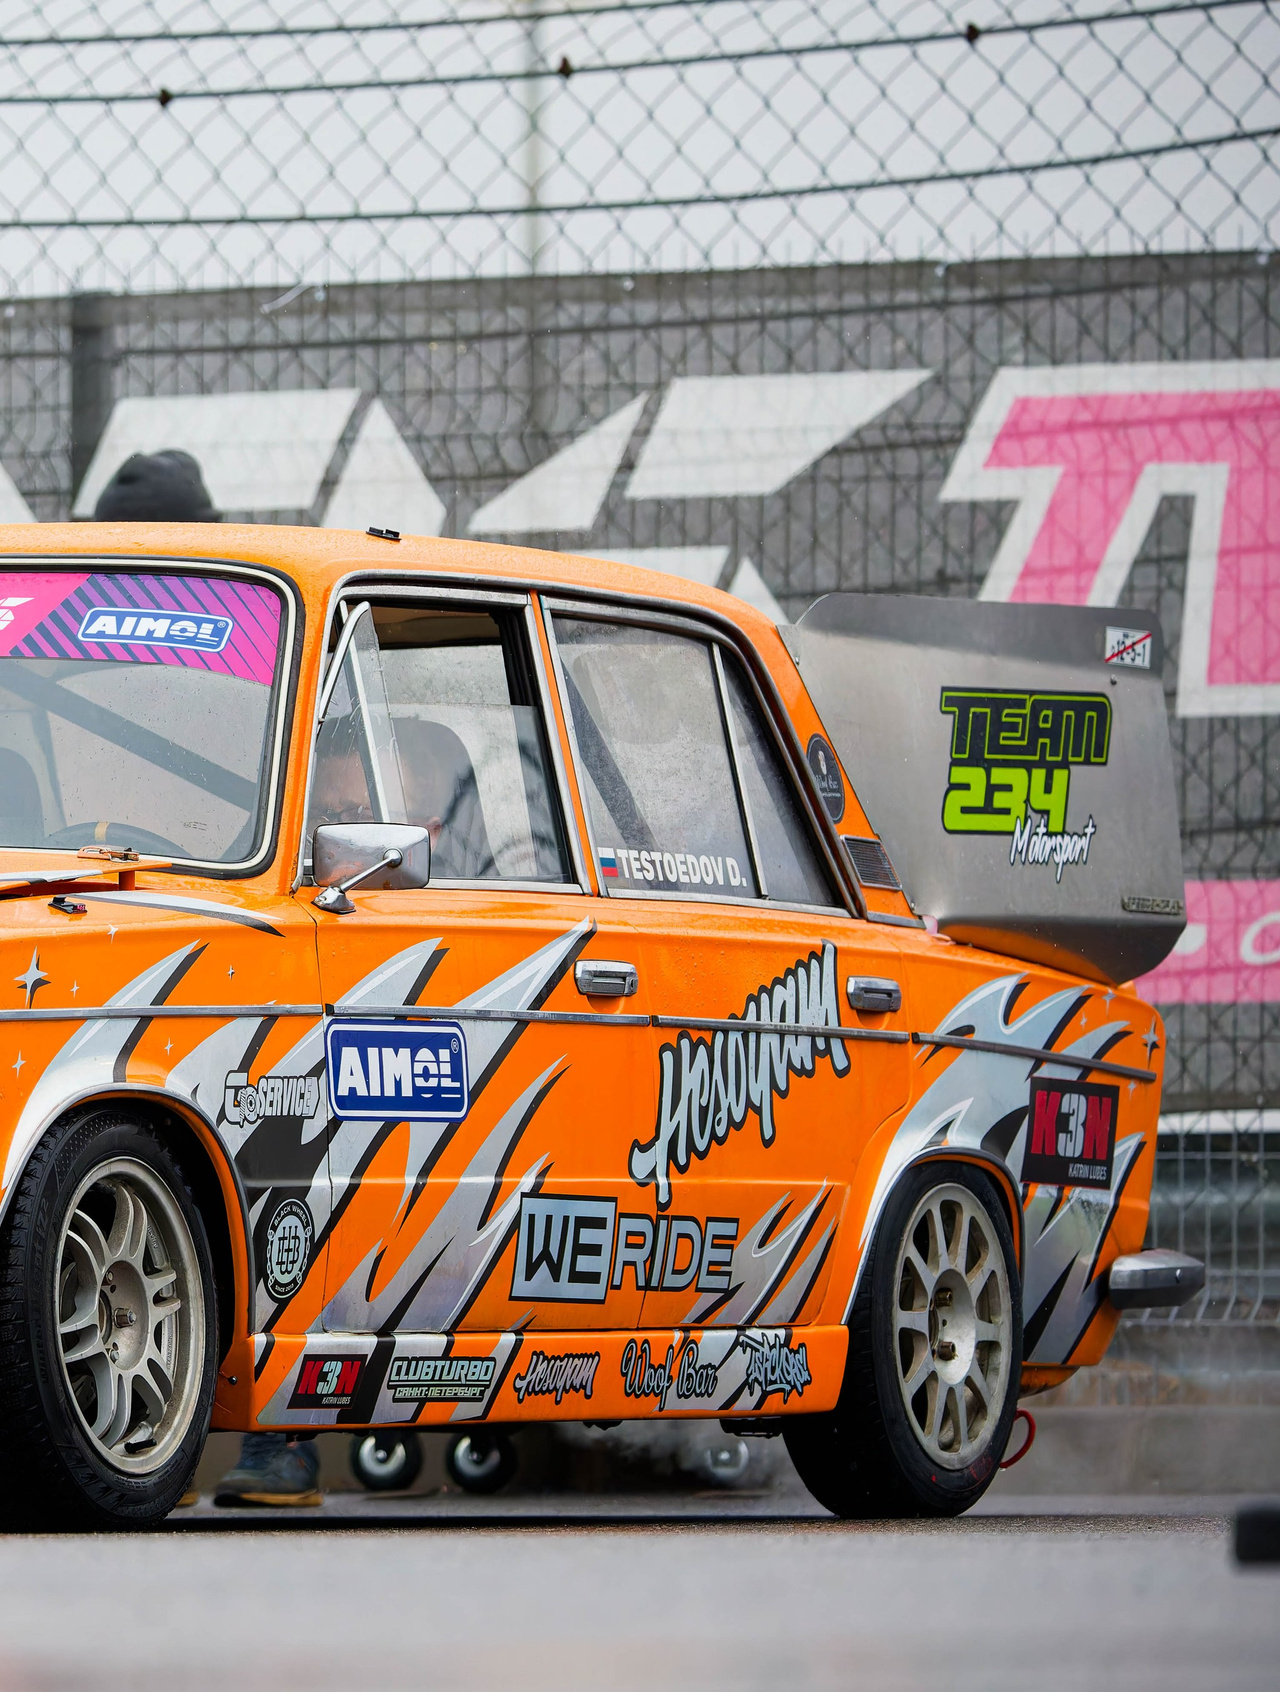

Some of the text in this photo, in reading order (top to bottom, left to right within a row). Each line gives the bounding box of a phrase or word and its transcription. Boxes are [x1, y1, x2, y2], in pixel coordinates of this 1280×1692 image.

[84, 615, 220, 645] AIMOL
[941, 686, 1112, 765] TEAM
[942, 766, 1071, 835] 234
[616, 848, 748, 887] TESTOEDOV D.
[1010, 815, 1097, 883] Motorsport
[337, 1047, 461, 1098] AIMOL
[257, 1076, 317, 1117] SERVICE
[273, 1204, 308, 1227] BLACK WHEEL
[389, 1360, 495, 1384] CLUBTURBO
[621, 1338, 719, 1412] Woof Bar
